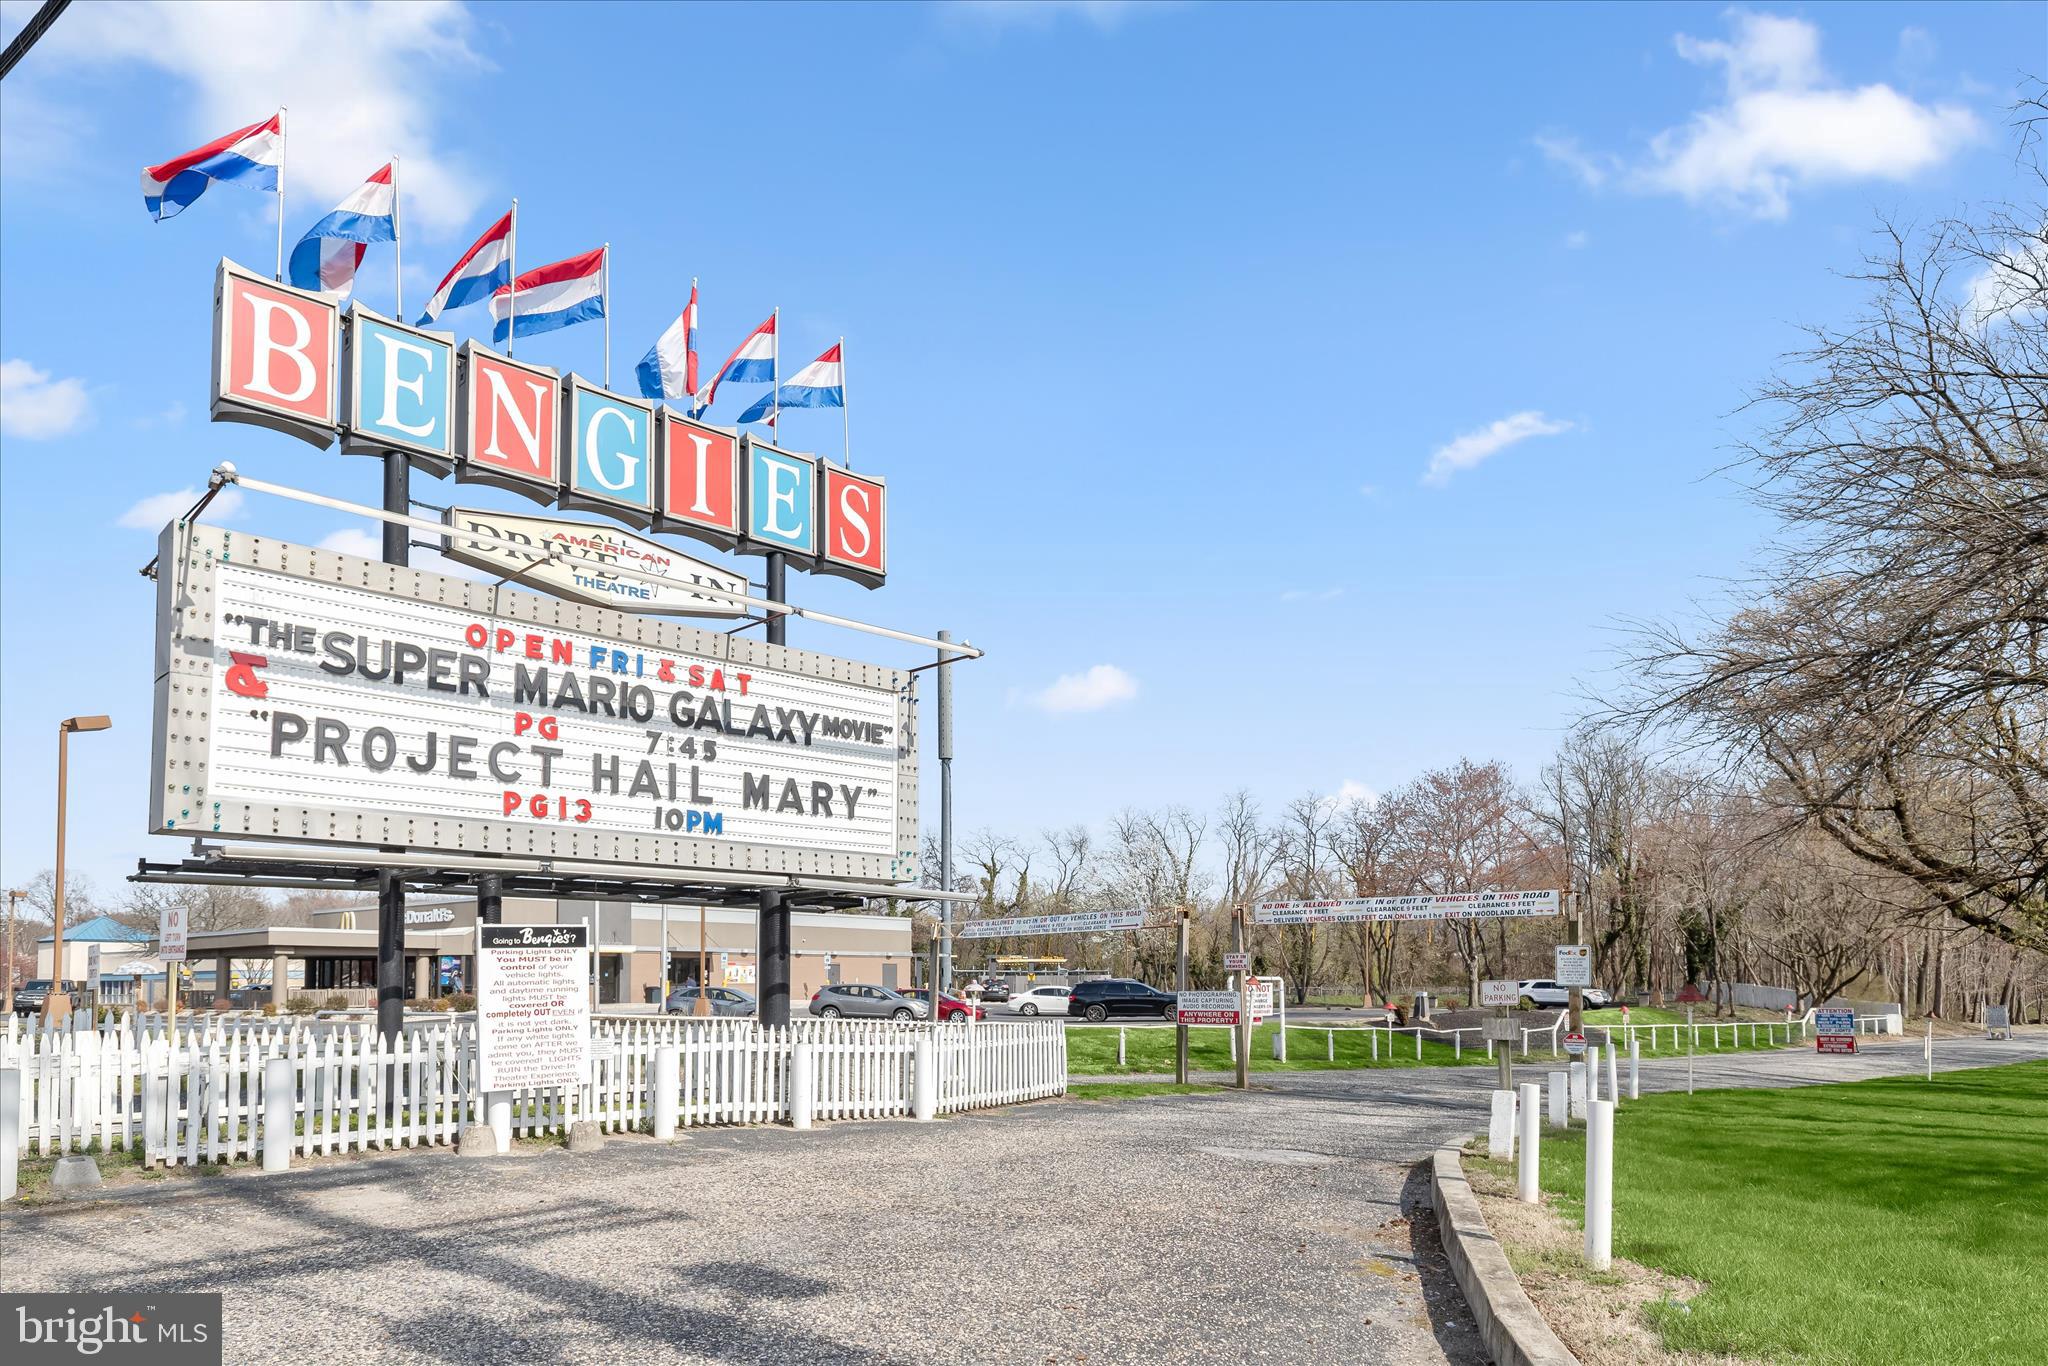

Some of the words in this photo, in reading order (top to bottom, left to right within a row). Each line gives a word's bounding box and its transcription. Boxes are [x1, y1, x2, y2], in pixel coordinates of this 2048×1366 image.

[242, 292, 871, 558] BENGIES
[552, 532, 671, 567] AMERICAN
[591, 534, 634, 550] ALL
[573, 574, 650, 600] THEATRE
[465, 623, 573, 666] OPEN
[589, 645, 644, 678] FRI
[657, 658, 676, 682] &
[688, 665, 752, 696] SAT
[319, 630, 490, 698] SUPER
[514, 662, 655, 724] MARIO
[668, 690, 821, 746] GALAXY
[514, 711, 559, 741] PG
[645, 730, 718, 762] 7:45
[592, 752, 714, 805] HAIL
[503, 790, 593, 823] PG13
[654, 806, 723, 835] 10PM
[1303, 900, 1342, 908] ALLOWED
[1421, 896, 1434, 904] OF
[1436, 895, 1480, 903] VEHICLES
[168, 911, 179, 928] NO
[486, 1010, 531, 1019] completely
[1485, 994, 1517, 1002] PARKING
